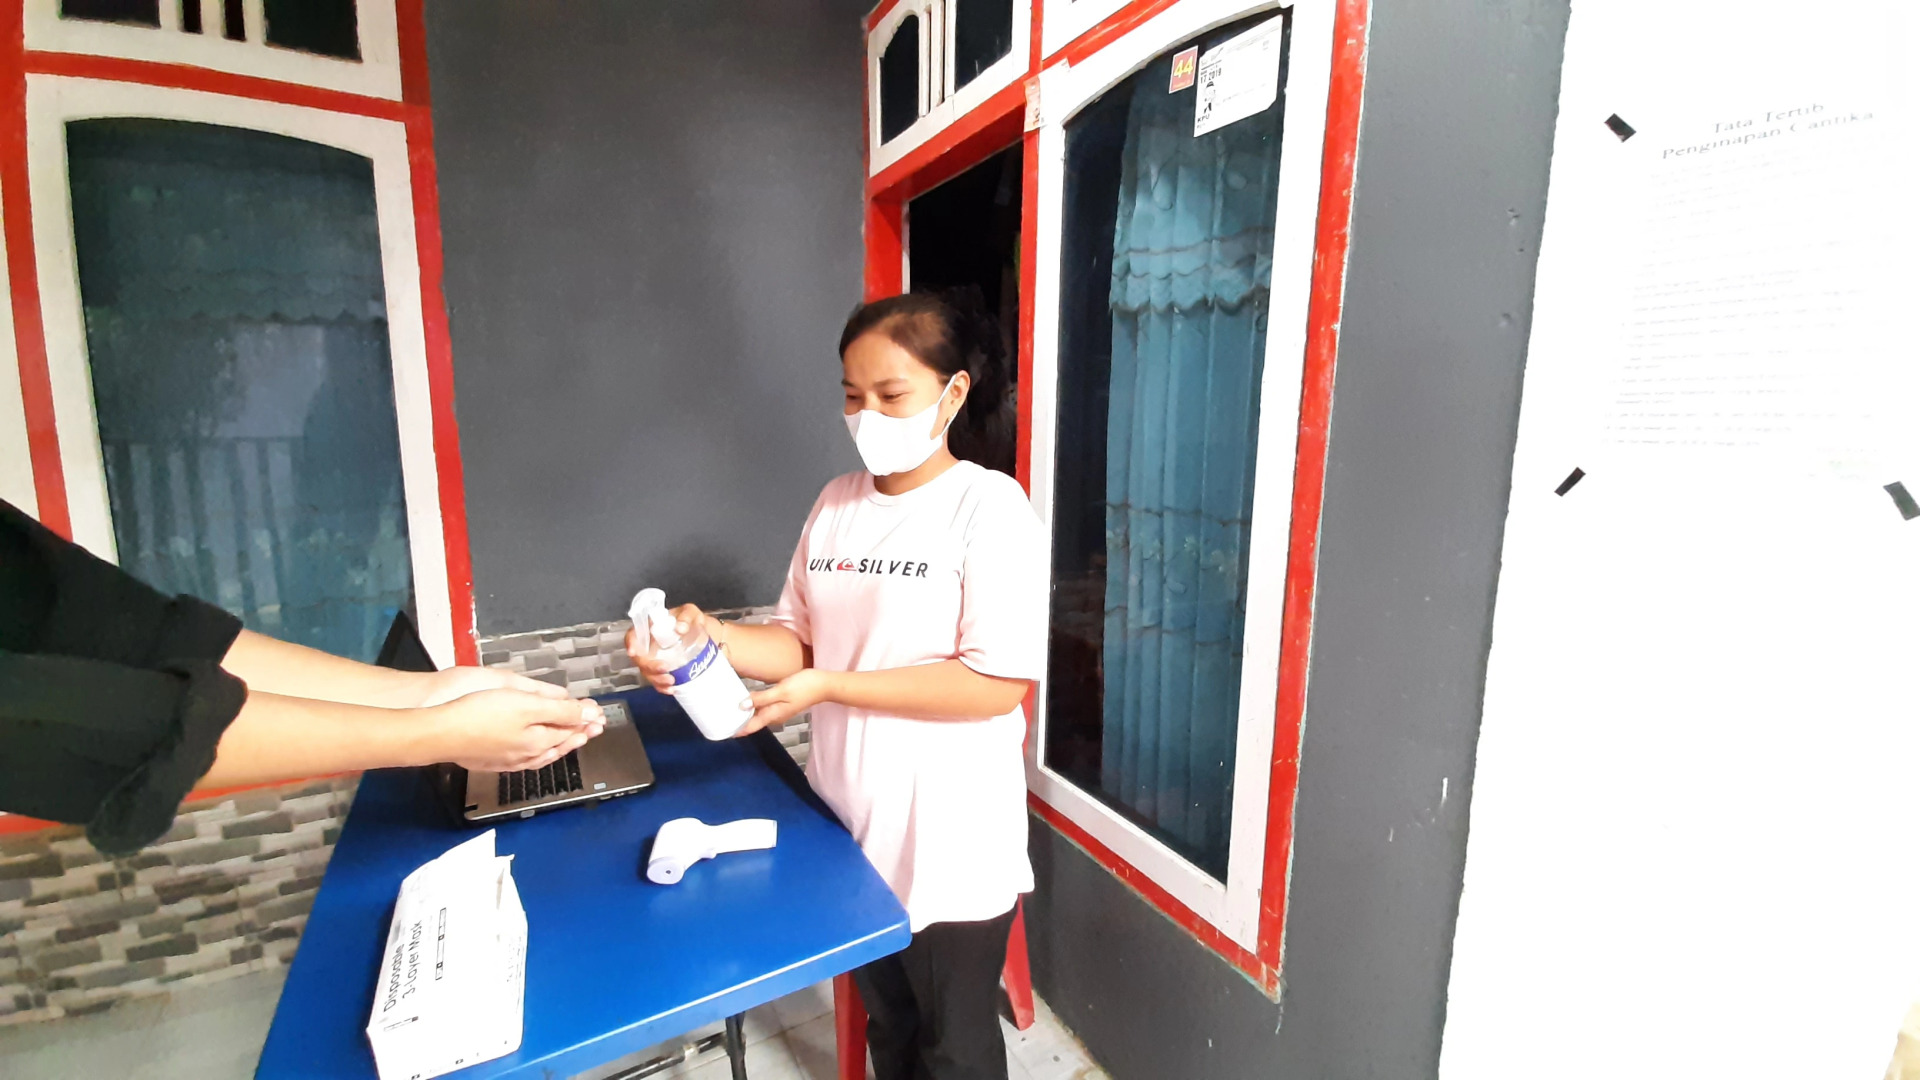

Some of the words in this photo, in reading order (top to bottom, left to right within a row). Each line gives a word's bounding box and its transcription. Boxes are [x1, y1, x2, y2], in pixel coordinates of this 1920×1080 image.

[1173, 55, 1194, 78] 44
[1200, 74, 1207, 84] 17
[1197, 113, 1210, 123] KPU
[1714, 119, 1753, 133] Tata
[1765, 103, 1824, 122] Tertib
[1662, 127, 1781, 159] Penginapan
[809, 558, 835, 572] UIK
[858, 558, 928, 578] SILVER
[408, 919, 423, 952] Mask
